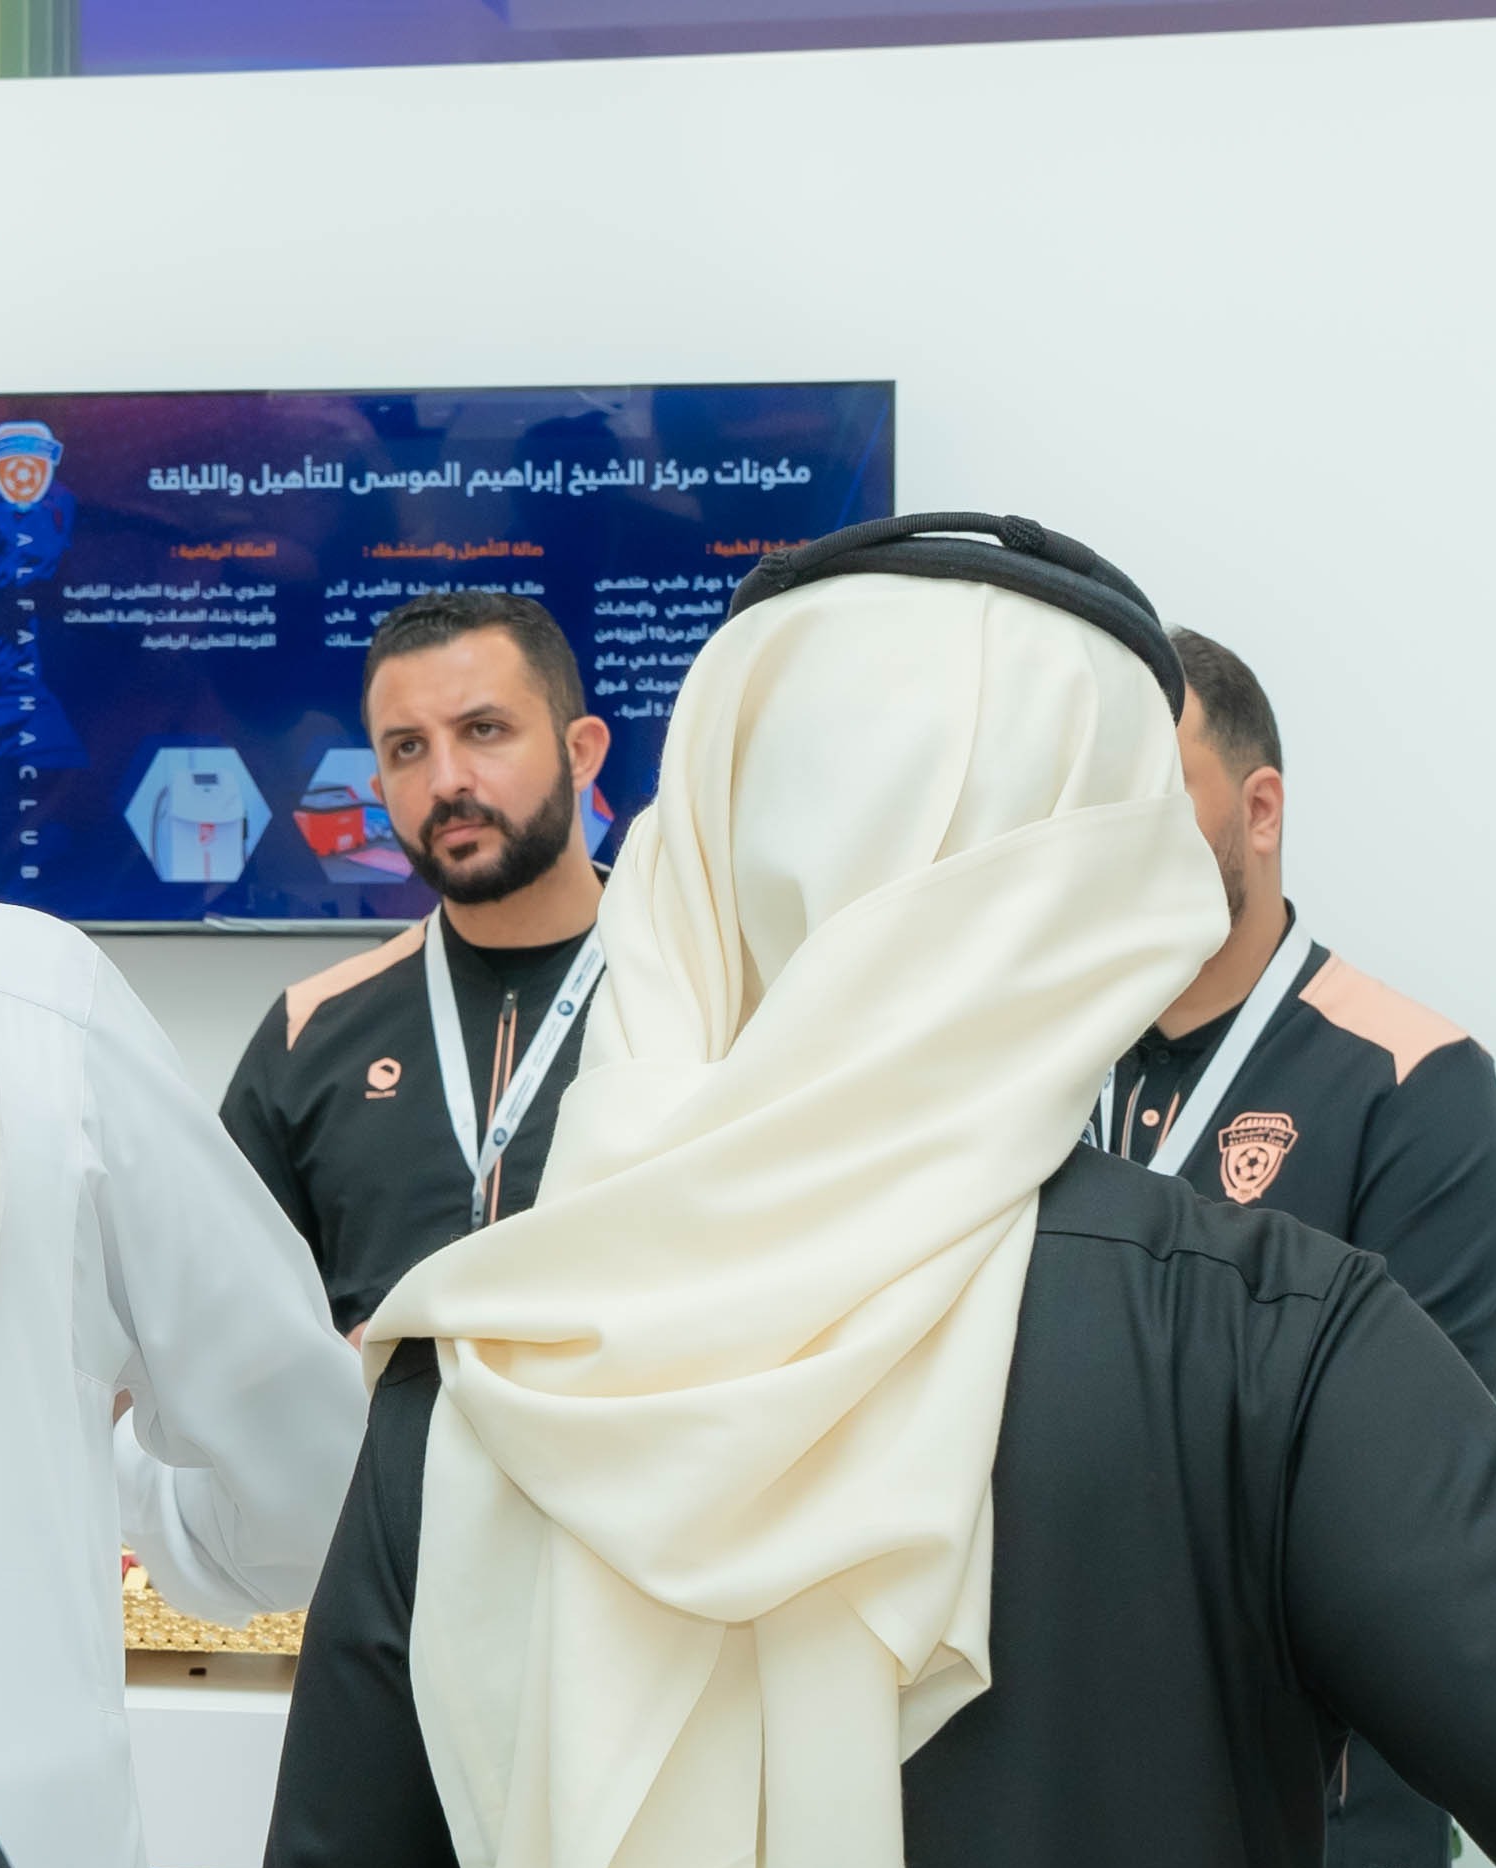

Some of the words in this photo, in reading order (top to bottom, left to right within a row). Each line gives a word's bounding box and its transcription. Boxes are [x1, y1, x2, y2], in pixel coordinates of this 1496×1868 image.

[147, 464, 244, 496] واللياقة
[248, 454, 344, 495] للتأهيل
[349, 461, 461, 494] الموسى
[466, 461, 563, 497] إبراهيم
[568, 459, 646, 496] الشيخ
[650, 458, 709, 492] مركز
[714, 457, 812, 491] مكونات
